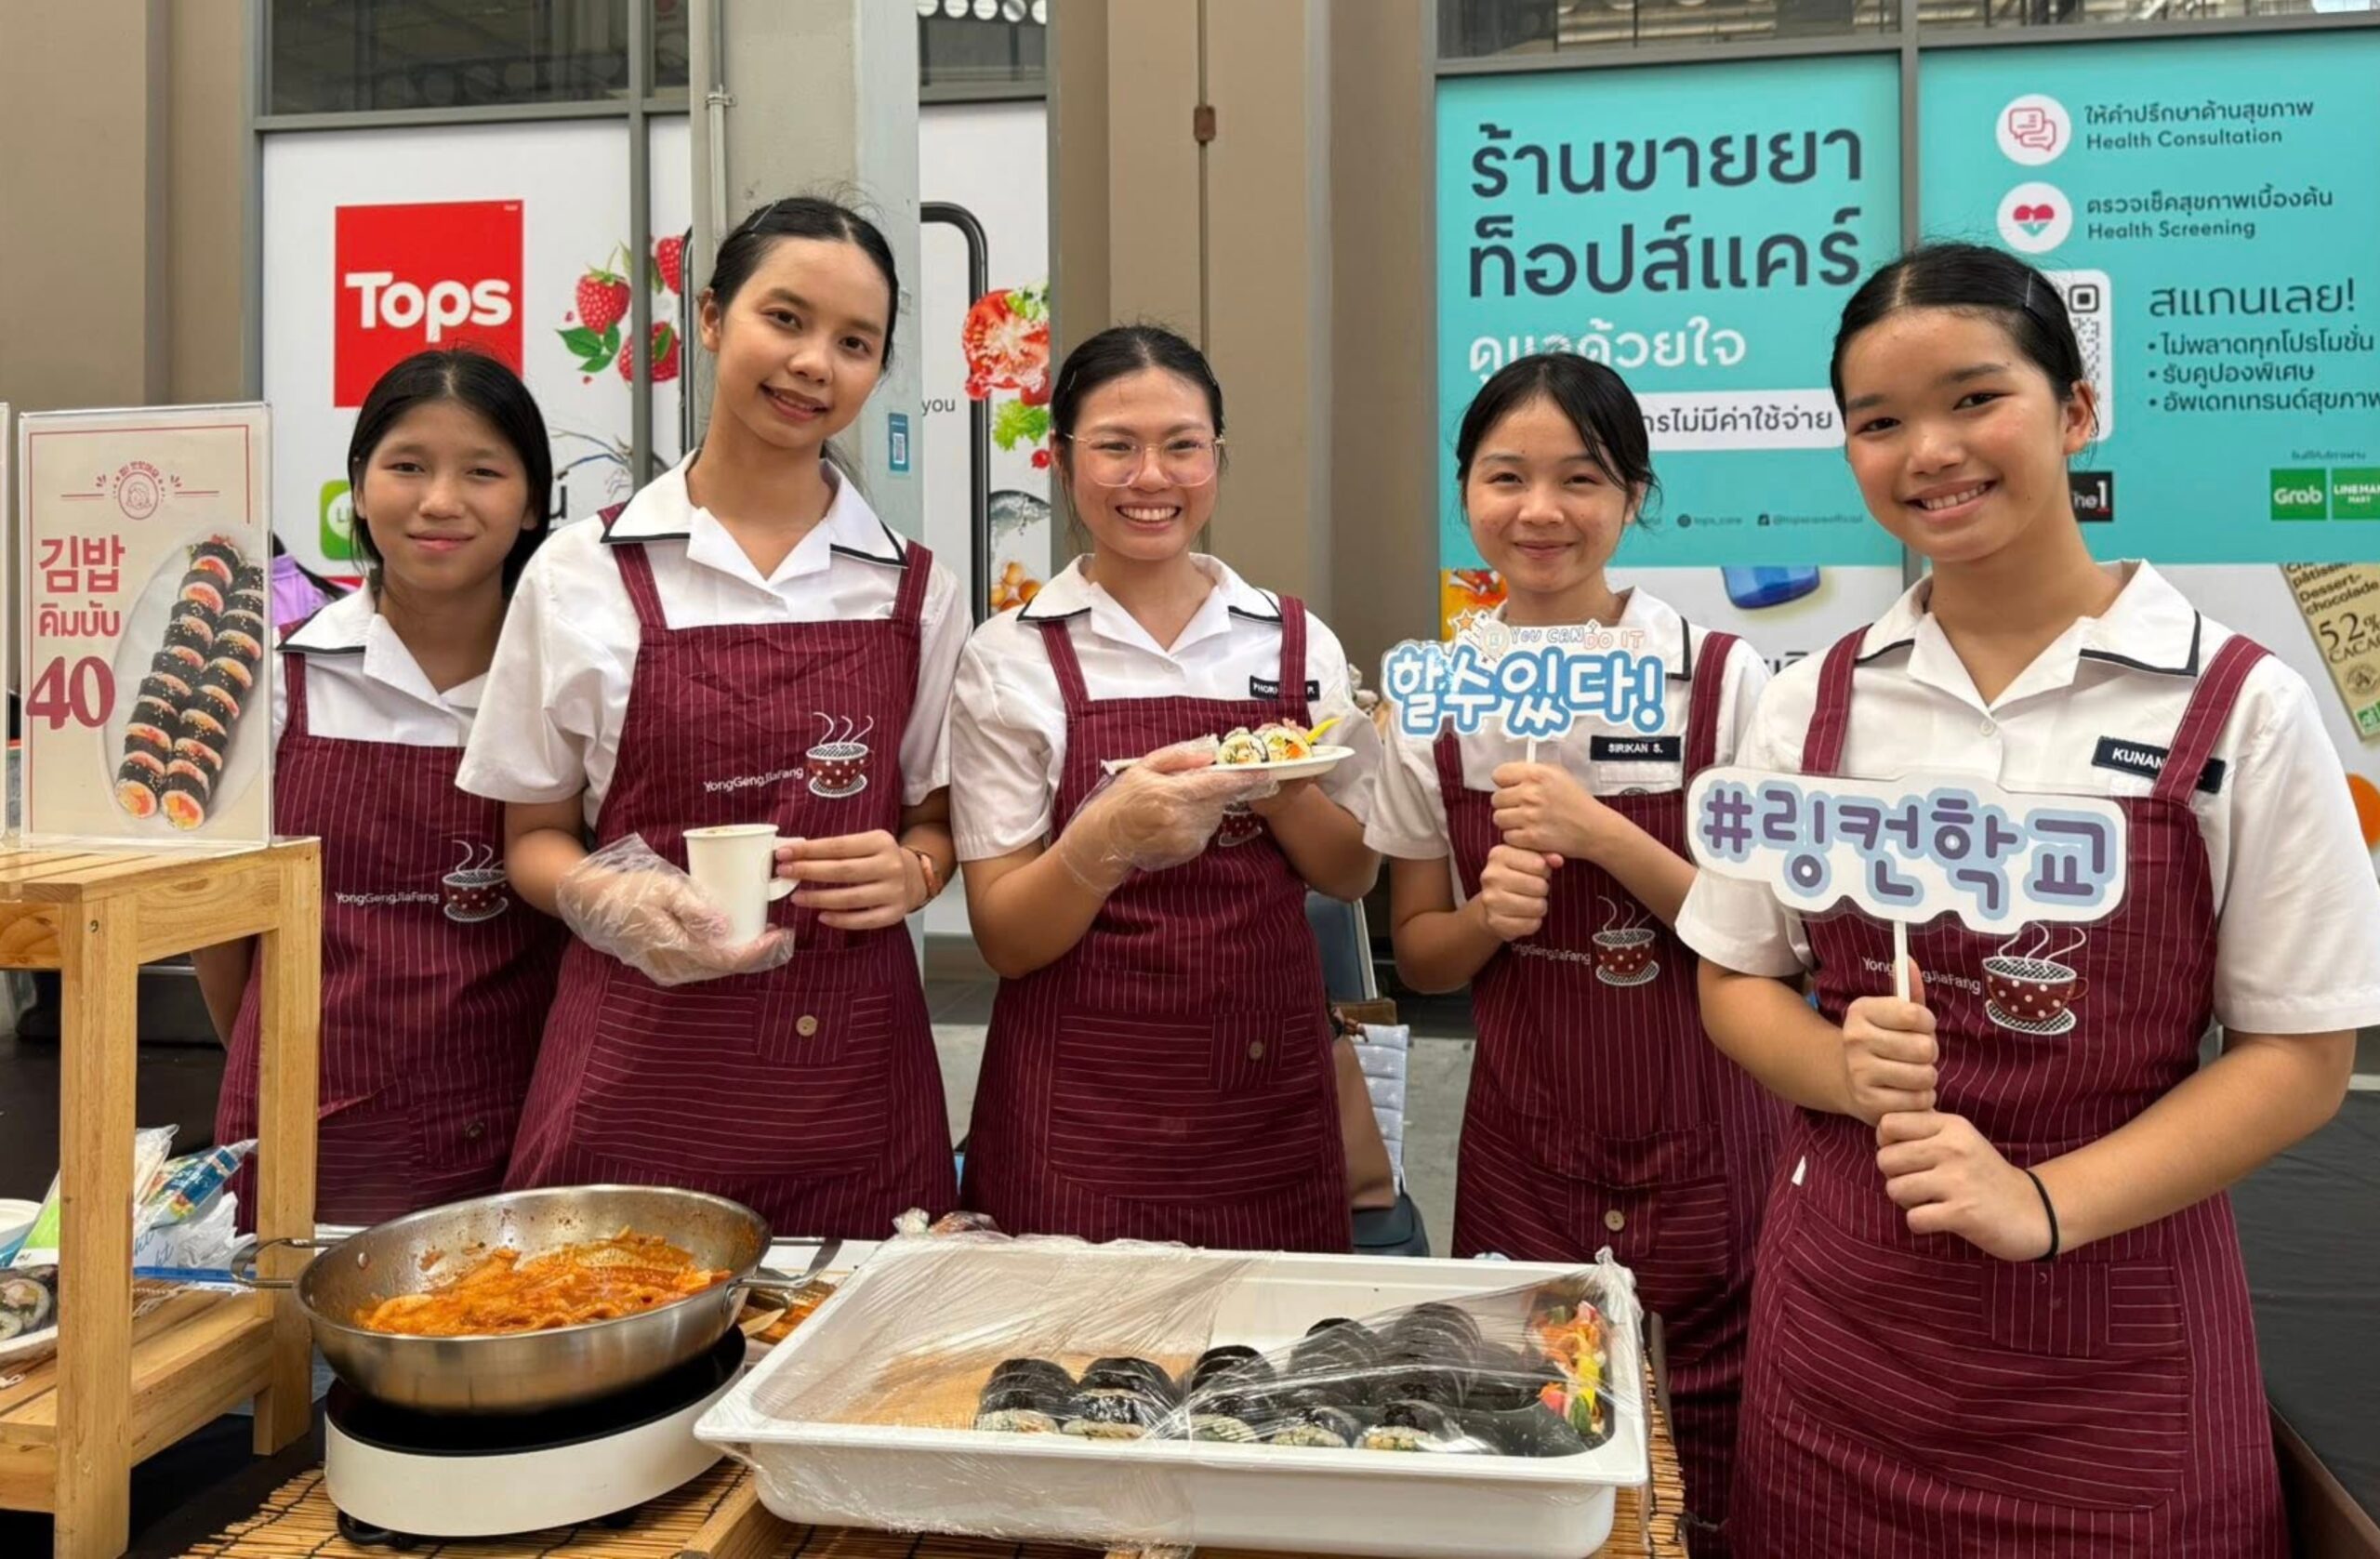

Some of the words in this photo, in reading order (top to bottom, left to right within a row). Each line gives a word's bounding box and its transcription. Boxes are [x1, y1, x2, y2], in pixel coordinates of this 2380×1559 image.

[2084, 99, 2315, 125] ให้คำปรึกษาด้านสุขภาพ
[2086, 132, 2151, 150] Health
[2157, 127, 2283, 148] Consultation
[1471, 123, 1862, 198] ร้านขายยา
[2086, 182, 2334, 217] ตรวจเช็คสุขภาพเบื้องต้น
[2087, 222, 2153, 240] Health
[2159, 218, 2256, 239] Screening
[1469, 206, 1862, 298] ท็อปส์แคร์
[345, 271, 512, 343] Tops
[2149, 277, 2355, 317] สแกนเลย!
[2161, 324, 2374, 359] ไม่พลาดทุกโปรโมชั่น
[2162, 362, 2315, 390] รับคูปองพิเศษ
[921, 399, 956, 416] you
[2274, 484, 2323, 505] Grab
[38, 534, 126, 593] 김밥
[2306, 580, 2380, 616] chocolade
[39, 600, 121, 638] คิมบับ
[26, 654, 116, 731] 40
[1389, 644, 1665, 735] 할수있다!
[1702, 787, 2108, 911] #링컨학교
[1511, 942, 1592, 966] ongGengJiaFang
